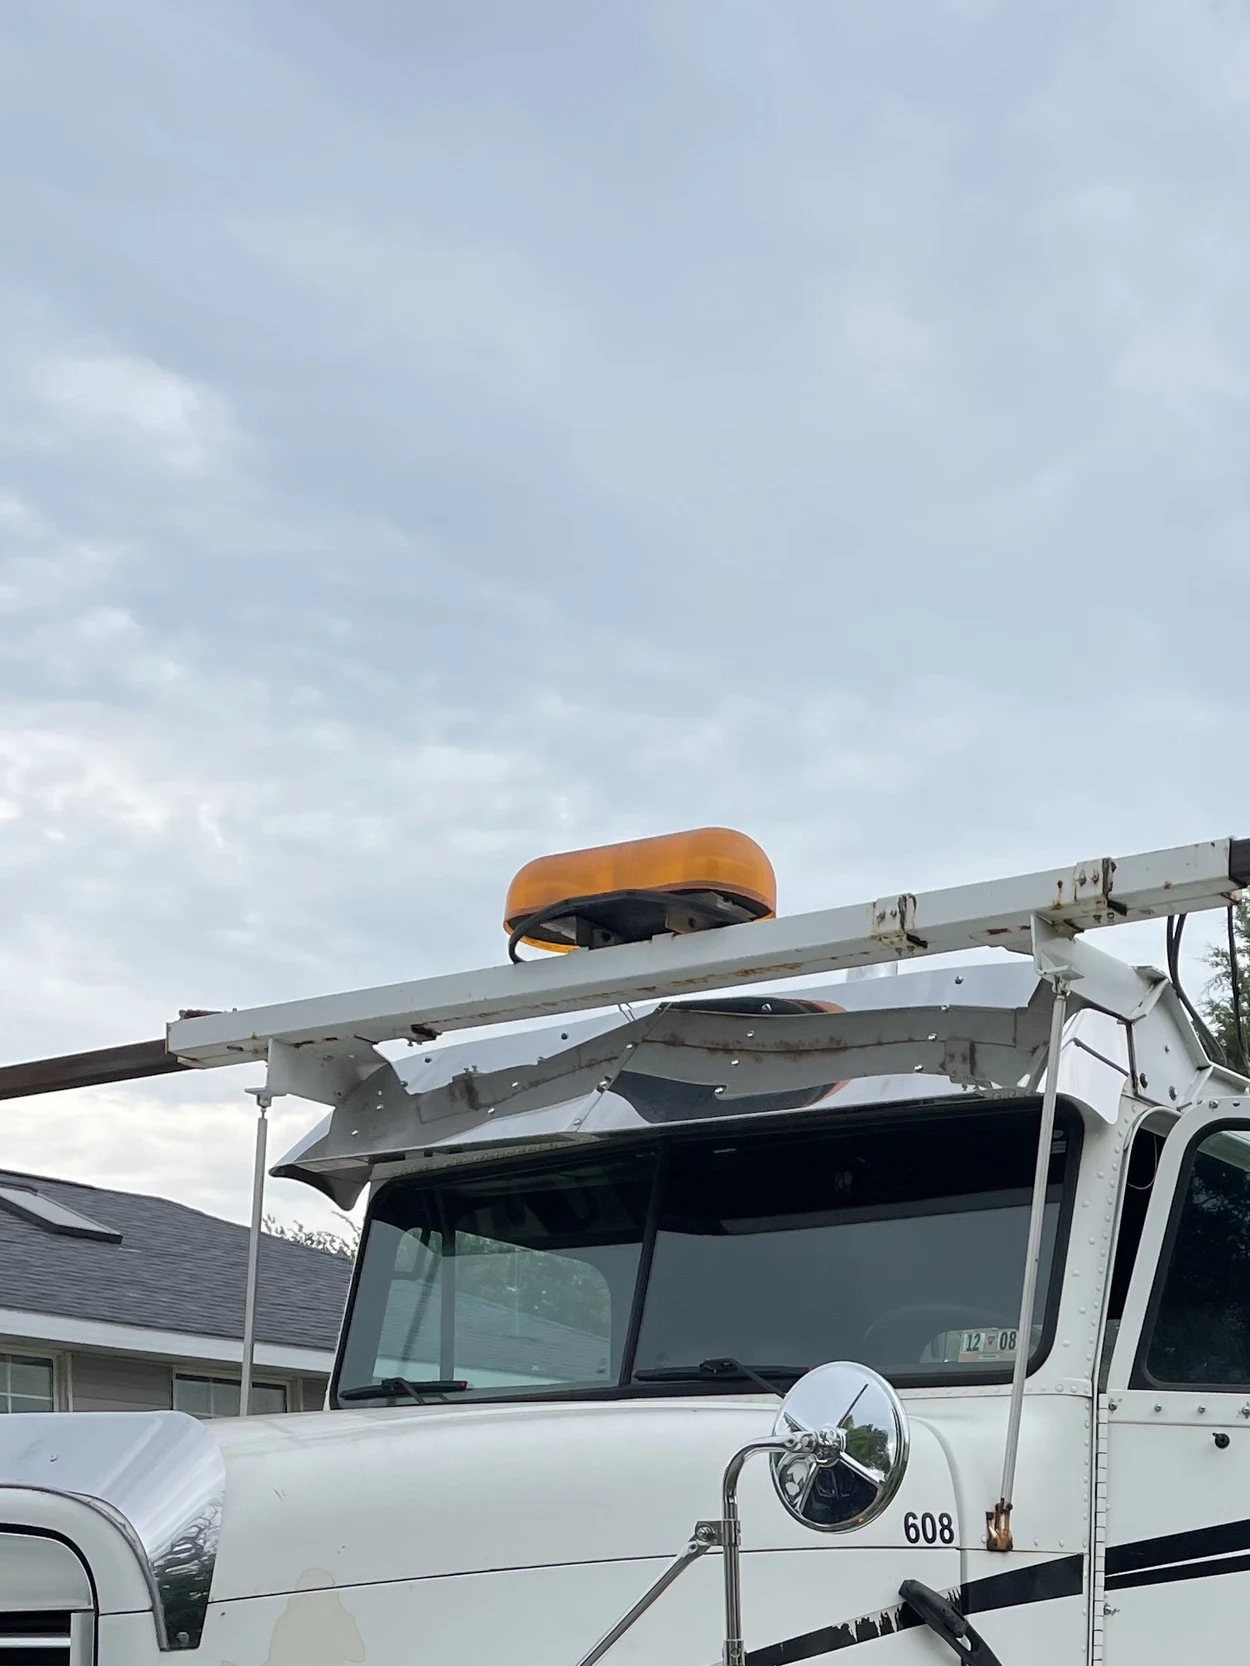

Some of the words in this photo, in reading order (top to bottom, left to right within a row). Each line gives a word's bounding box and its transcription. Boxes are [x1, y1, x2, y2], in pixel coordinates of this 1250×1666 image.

[966, 1333, 981, 1351] 12
[999, 1331, 1017, 1350] 08
[904, 1511, 954, 1544] 608
